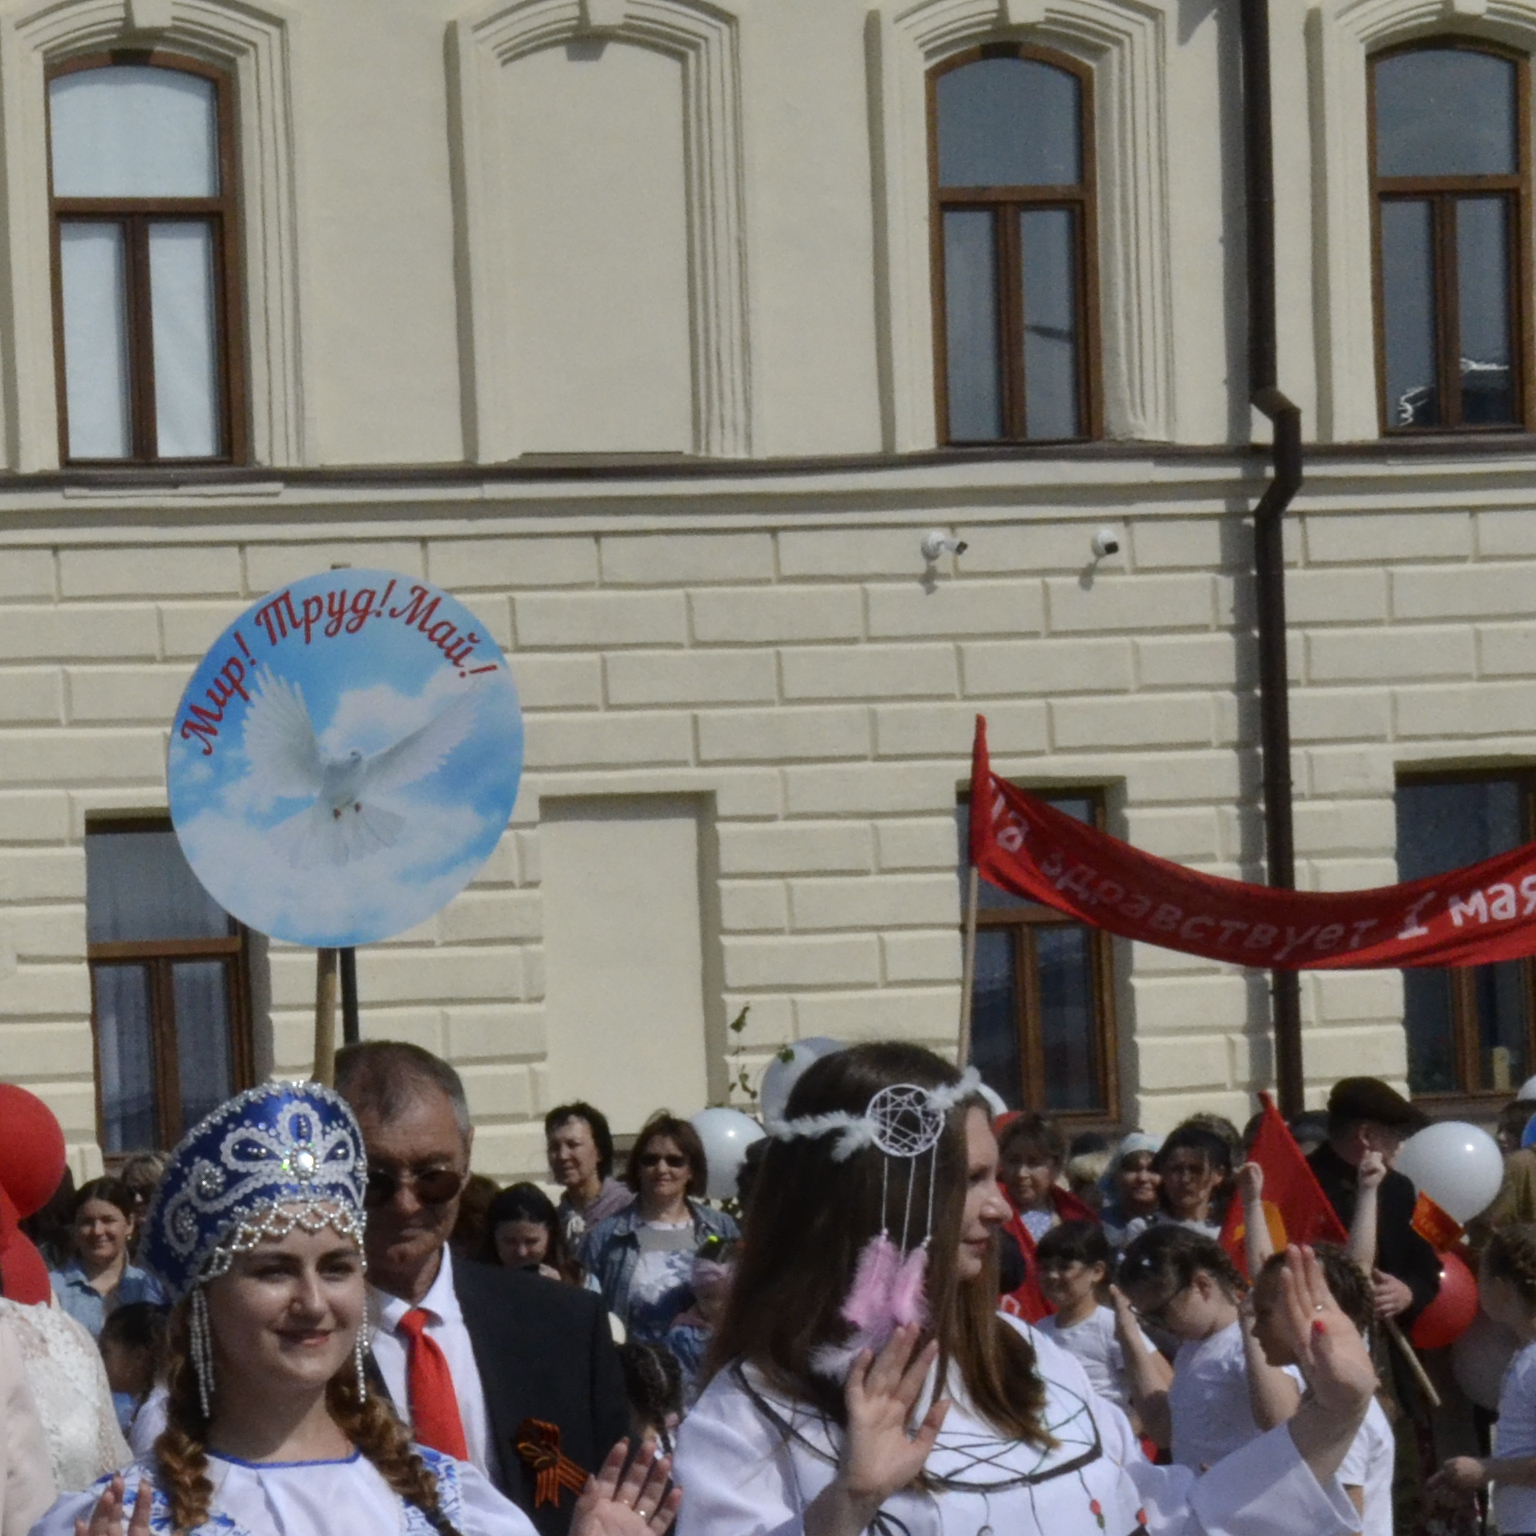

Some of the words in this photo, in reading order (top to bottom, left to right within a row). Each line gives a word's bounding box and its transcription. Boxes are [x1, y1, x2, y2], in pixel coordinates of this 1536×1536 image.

[180, 631, 257, 756] Мир!
[254, 579, 397, 646] Труд!
[390, 585, 498, 678] Май!
